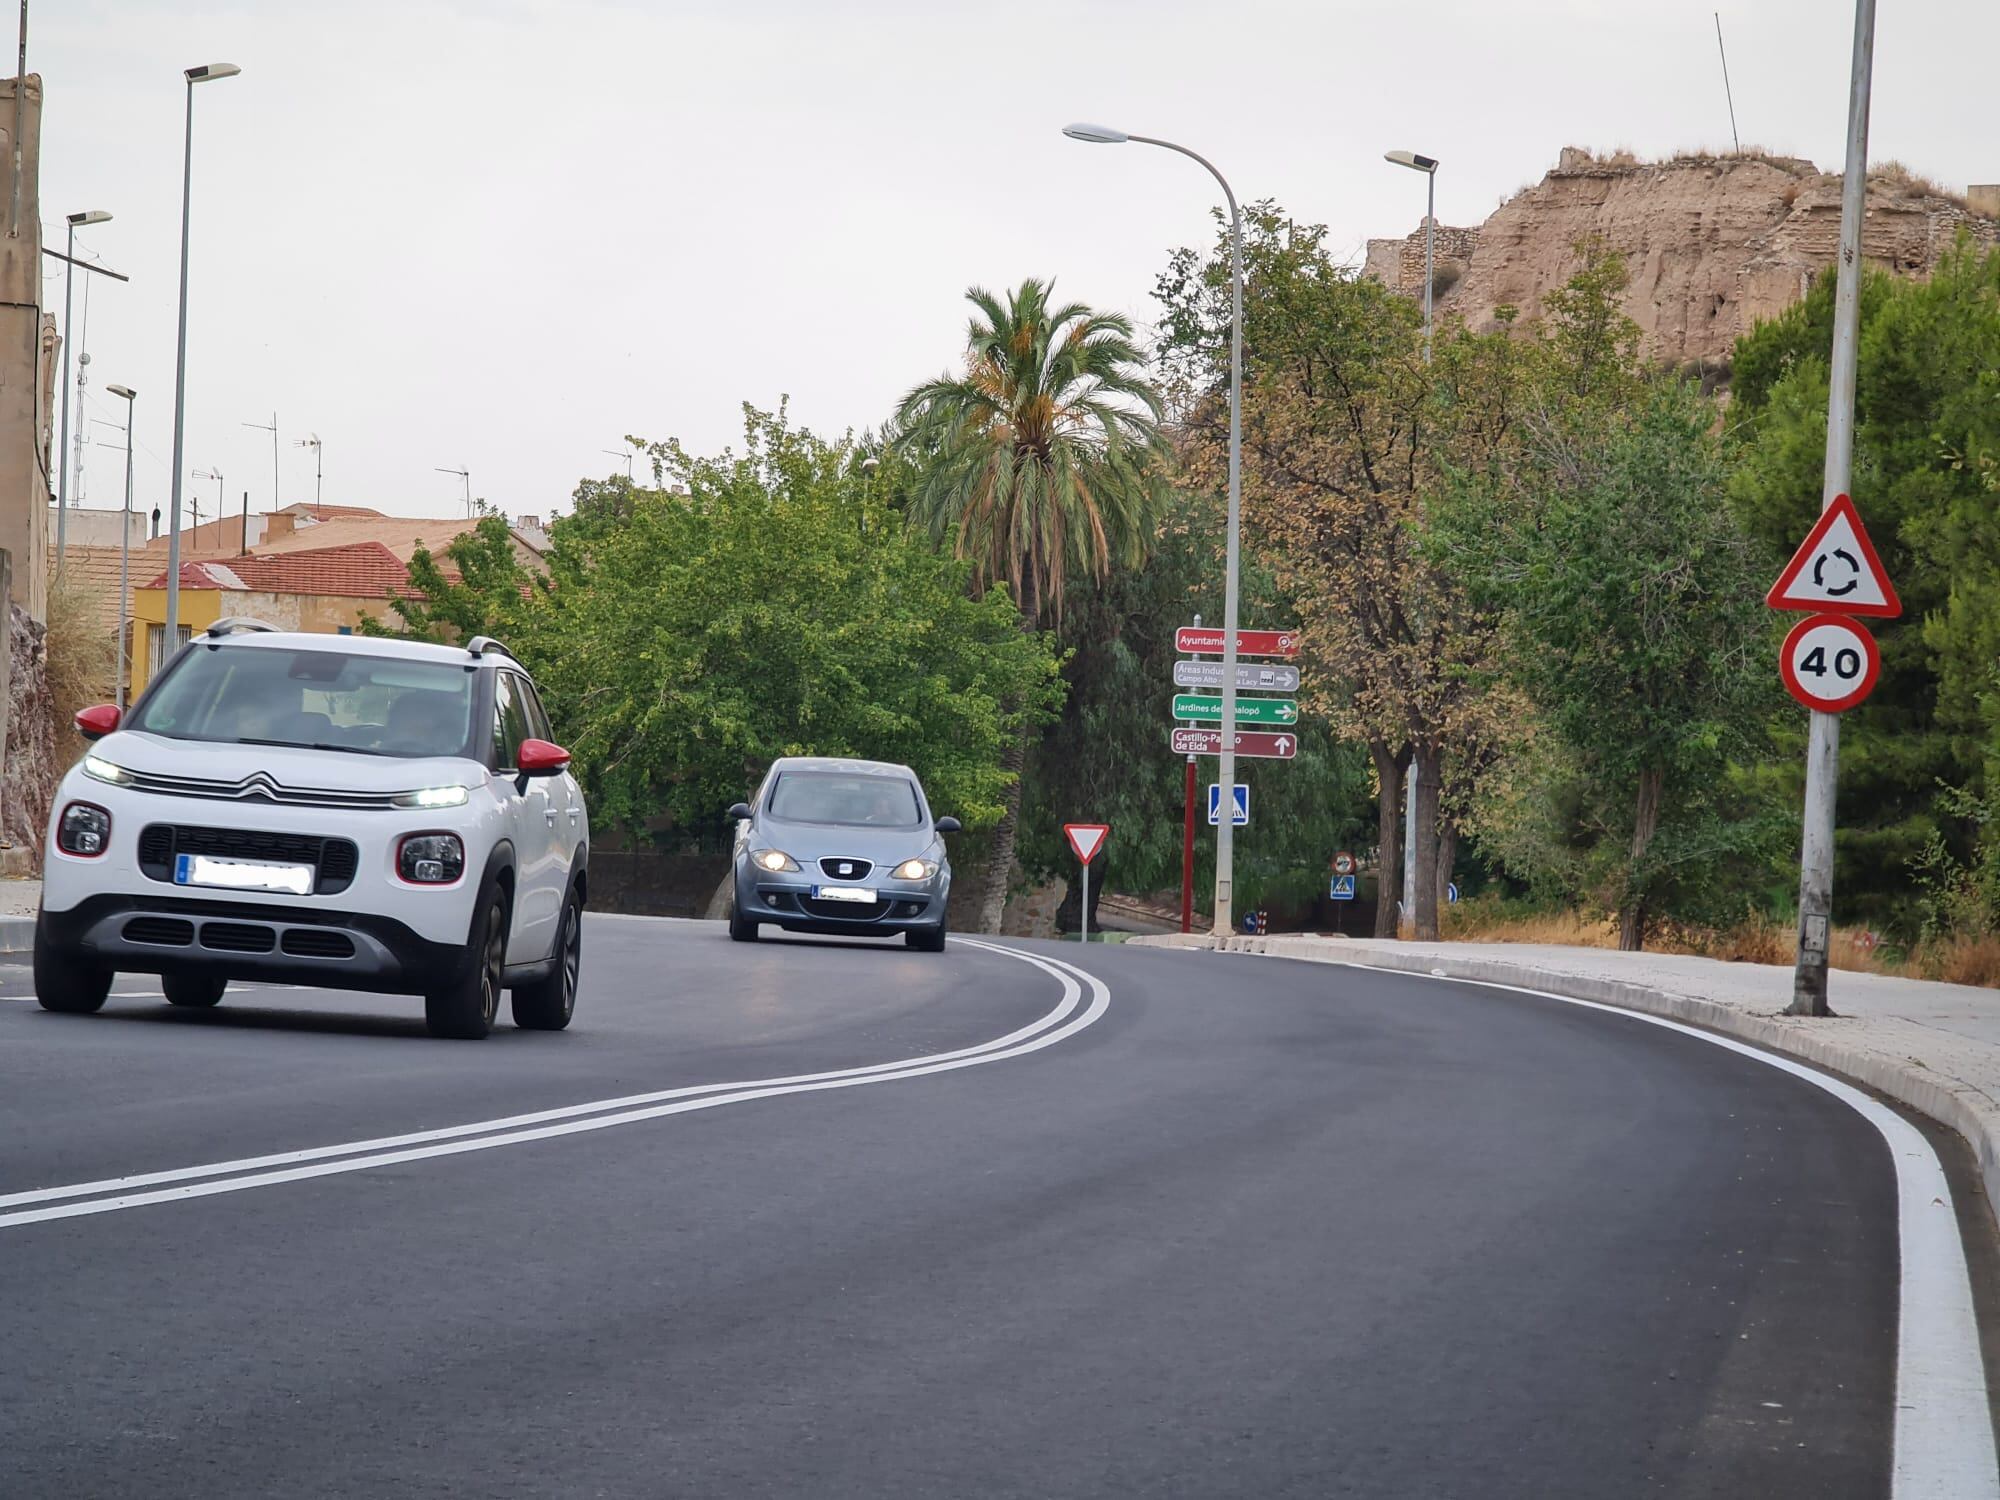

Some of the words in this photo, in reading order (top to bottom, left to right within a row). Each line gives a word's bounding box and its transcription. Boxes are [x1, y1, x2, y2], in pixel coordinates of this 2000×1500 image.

[1180, 636, 1243, 646] Ayuntamio
[1800, 647, 1860, 680] 40
[1176, 704, 1209, 712] Jardines
[1176, 733, 1241, 743] Castillo-Pao
[1175, 742, 1188, 750] de
[1189, 742, 1207, 751] Elda
